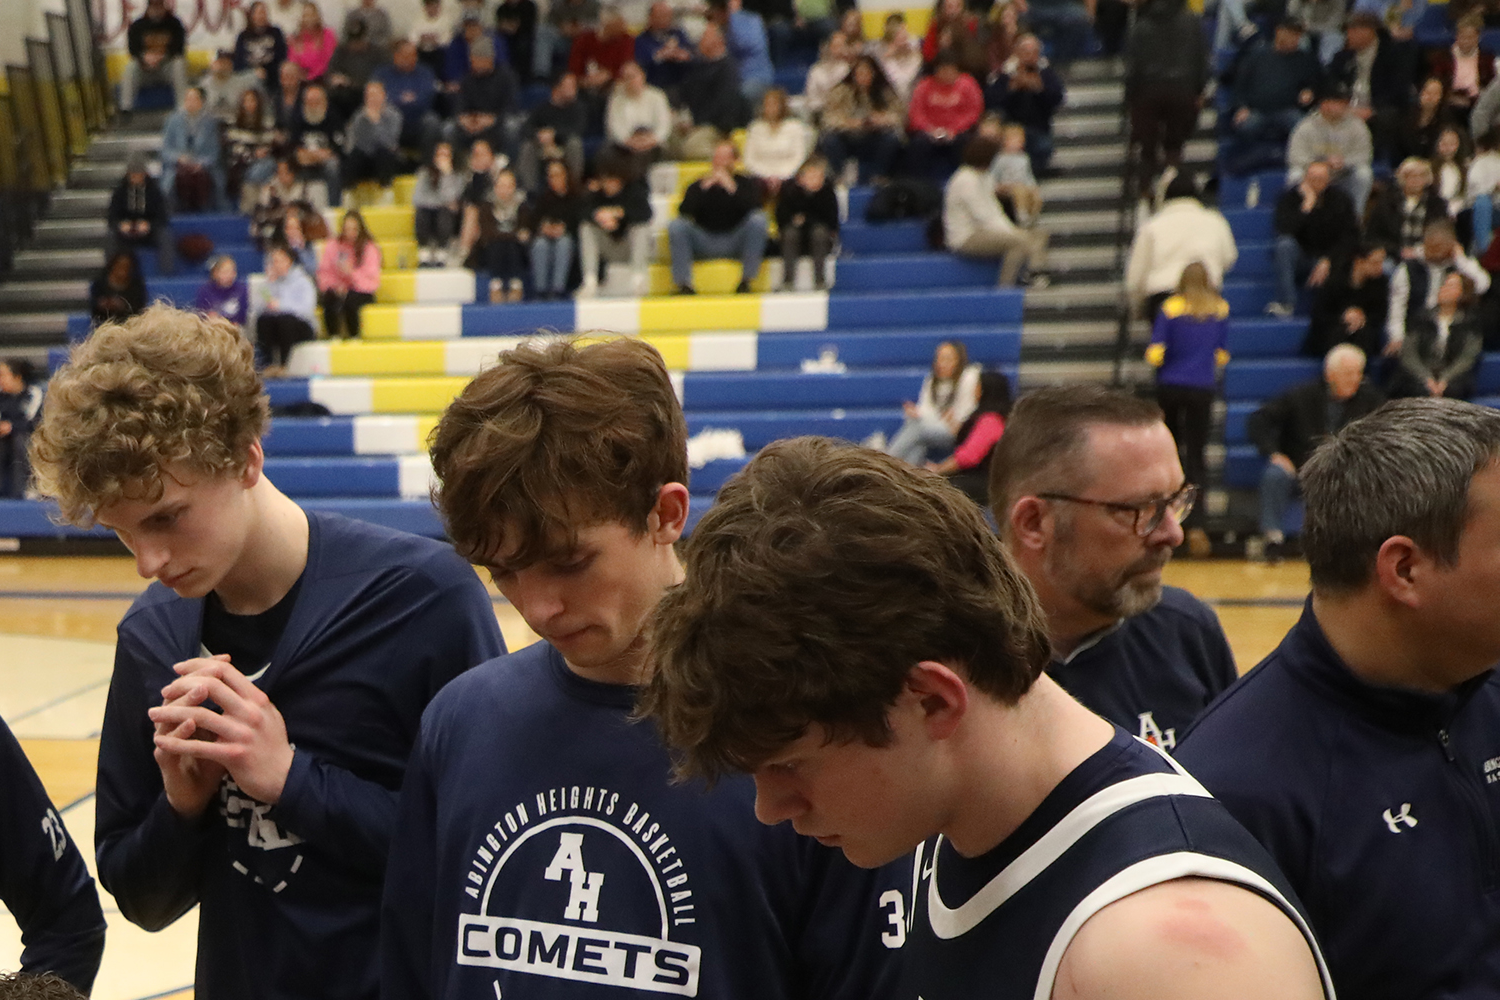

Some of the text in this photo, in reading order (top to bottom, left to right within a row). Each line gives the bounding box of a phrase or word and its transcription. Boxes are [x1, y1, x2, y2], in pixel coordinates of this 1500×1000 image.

[465, 785, 696, 926] ABINGTON HEIGHTS BASKETBALL
[544, 832, 605, 922] AH
[462, 923, 690, 987] COMETS
